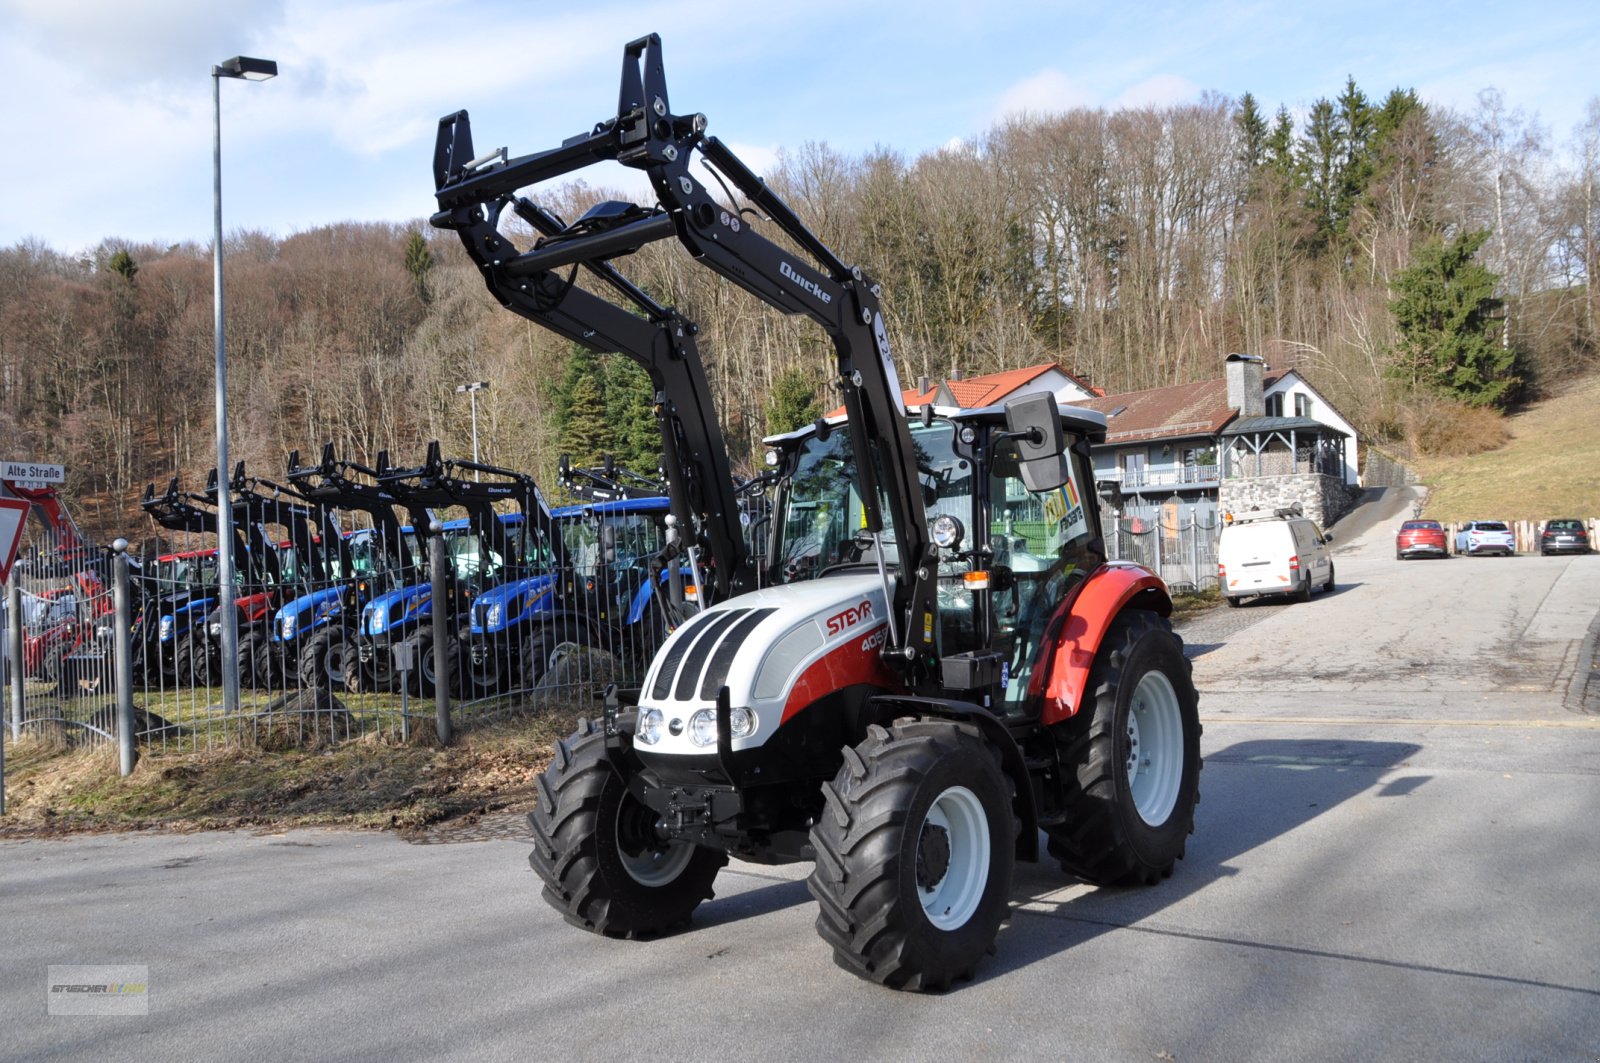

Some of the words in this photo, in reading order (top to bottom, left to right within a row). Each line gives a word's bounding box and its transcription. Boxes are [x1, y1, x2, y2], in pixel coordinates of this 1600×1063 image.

[780, 261, 832, 304] Quicke
[8, 465, 26, 477] Alte
[29, 465, 60, 479] Straße
[826, 600, 872, 637] STEYR
